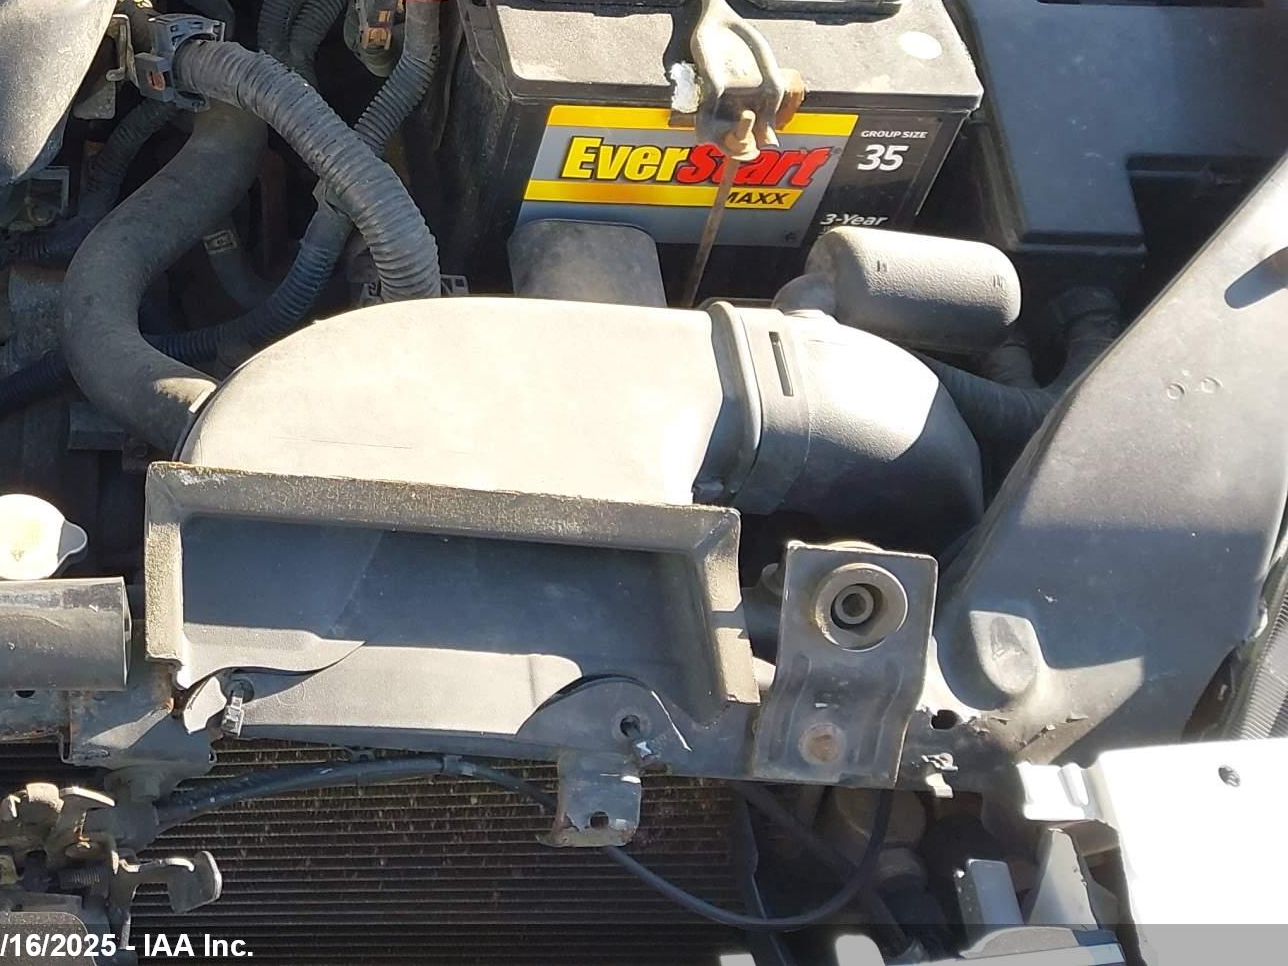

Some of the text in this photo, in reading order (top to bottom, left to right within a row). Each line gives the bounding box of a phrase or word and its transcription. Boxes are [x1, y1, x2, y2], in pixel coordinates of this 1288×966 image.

[861, 130, 928, 139] GROUP SIZE
[559, 135, 834, 187] EverSart
[857, 144, 910, 171] 35
[820, 213, 888, 226] 3-Year
